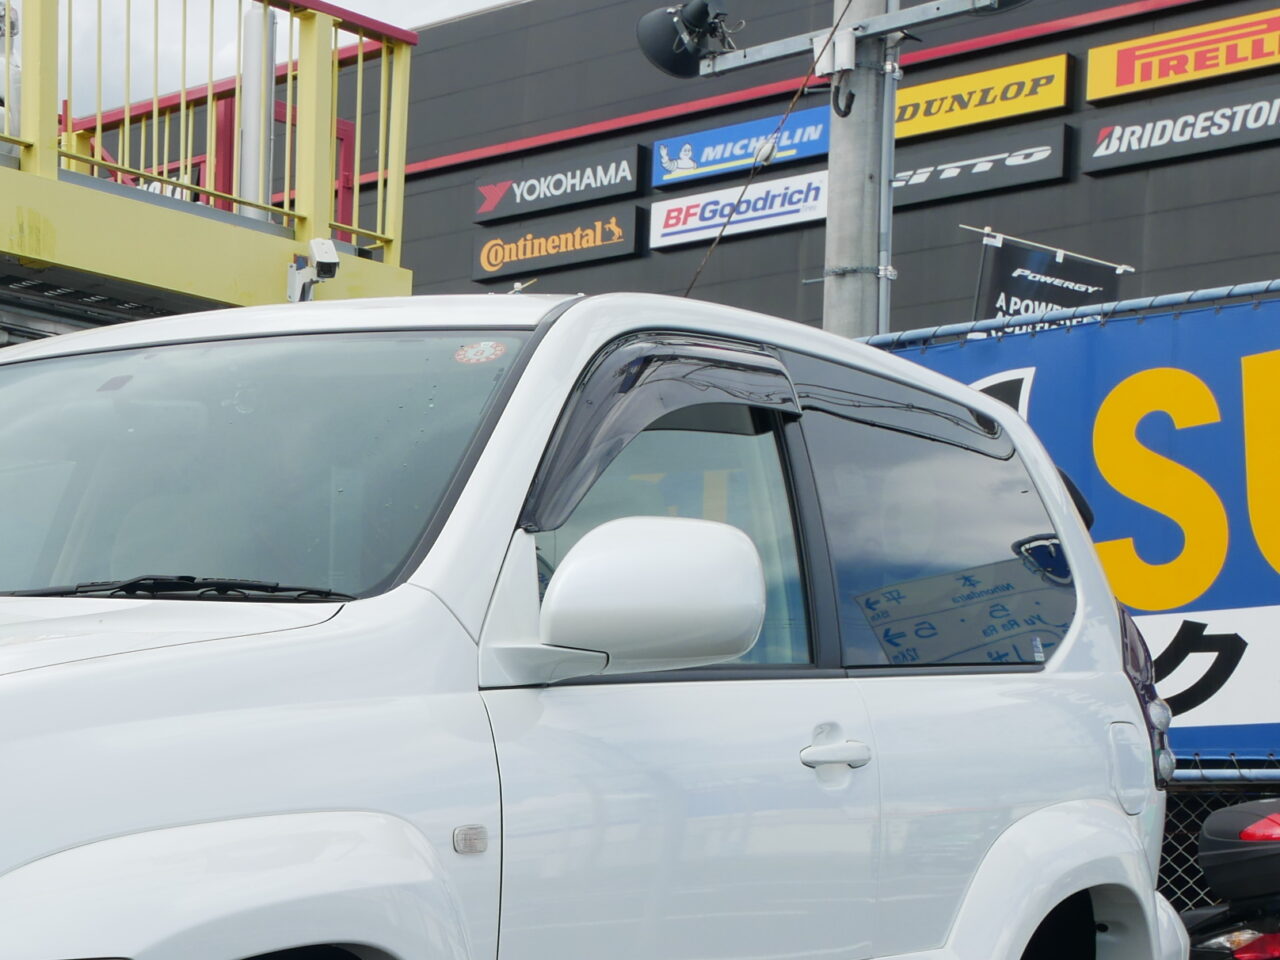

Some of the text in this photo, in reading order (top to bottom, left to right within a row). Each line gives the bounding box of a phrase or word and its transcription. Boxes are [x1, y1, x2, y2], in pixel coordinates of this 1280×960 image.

[1116, 17, 1280, 87] PIRELL
[896, 75, 1055, 123] DUNLOP
[512, 160, 632, 204] YOKOHAMA
[663, 182, 821, 230] BFGoodrich
[480, 221, 602, 272] Continental
[995, 292, 1006, 311] A
[1009, 296, 1066, 316] POW
